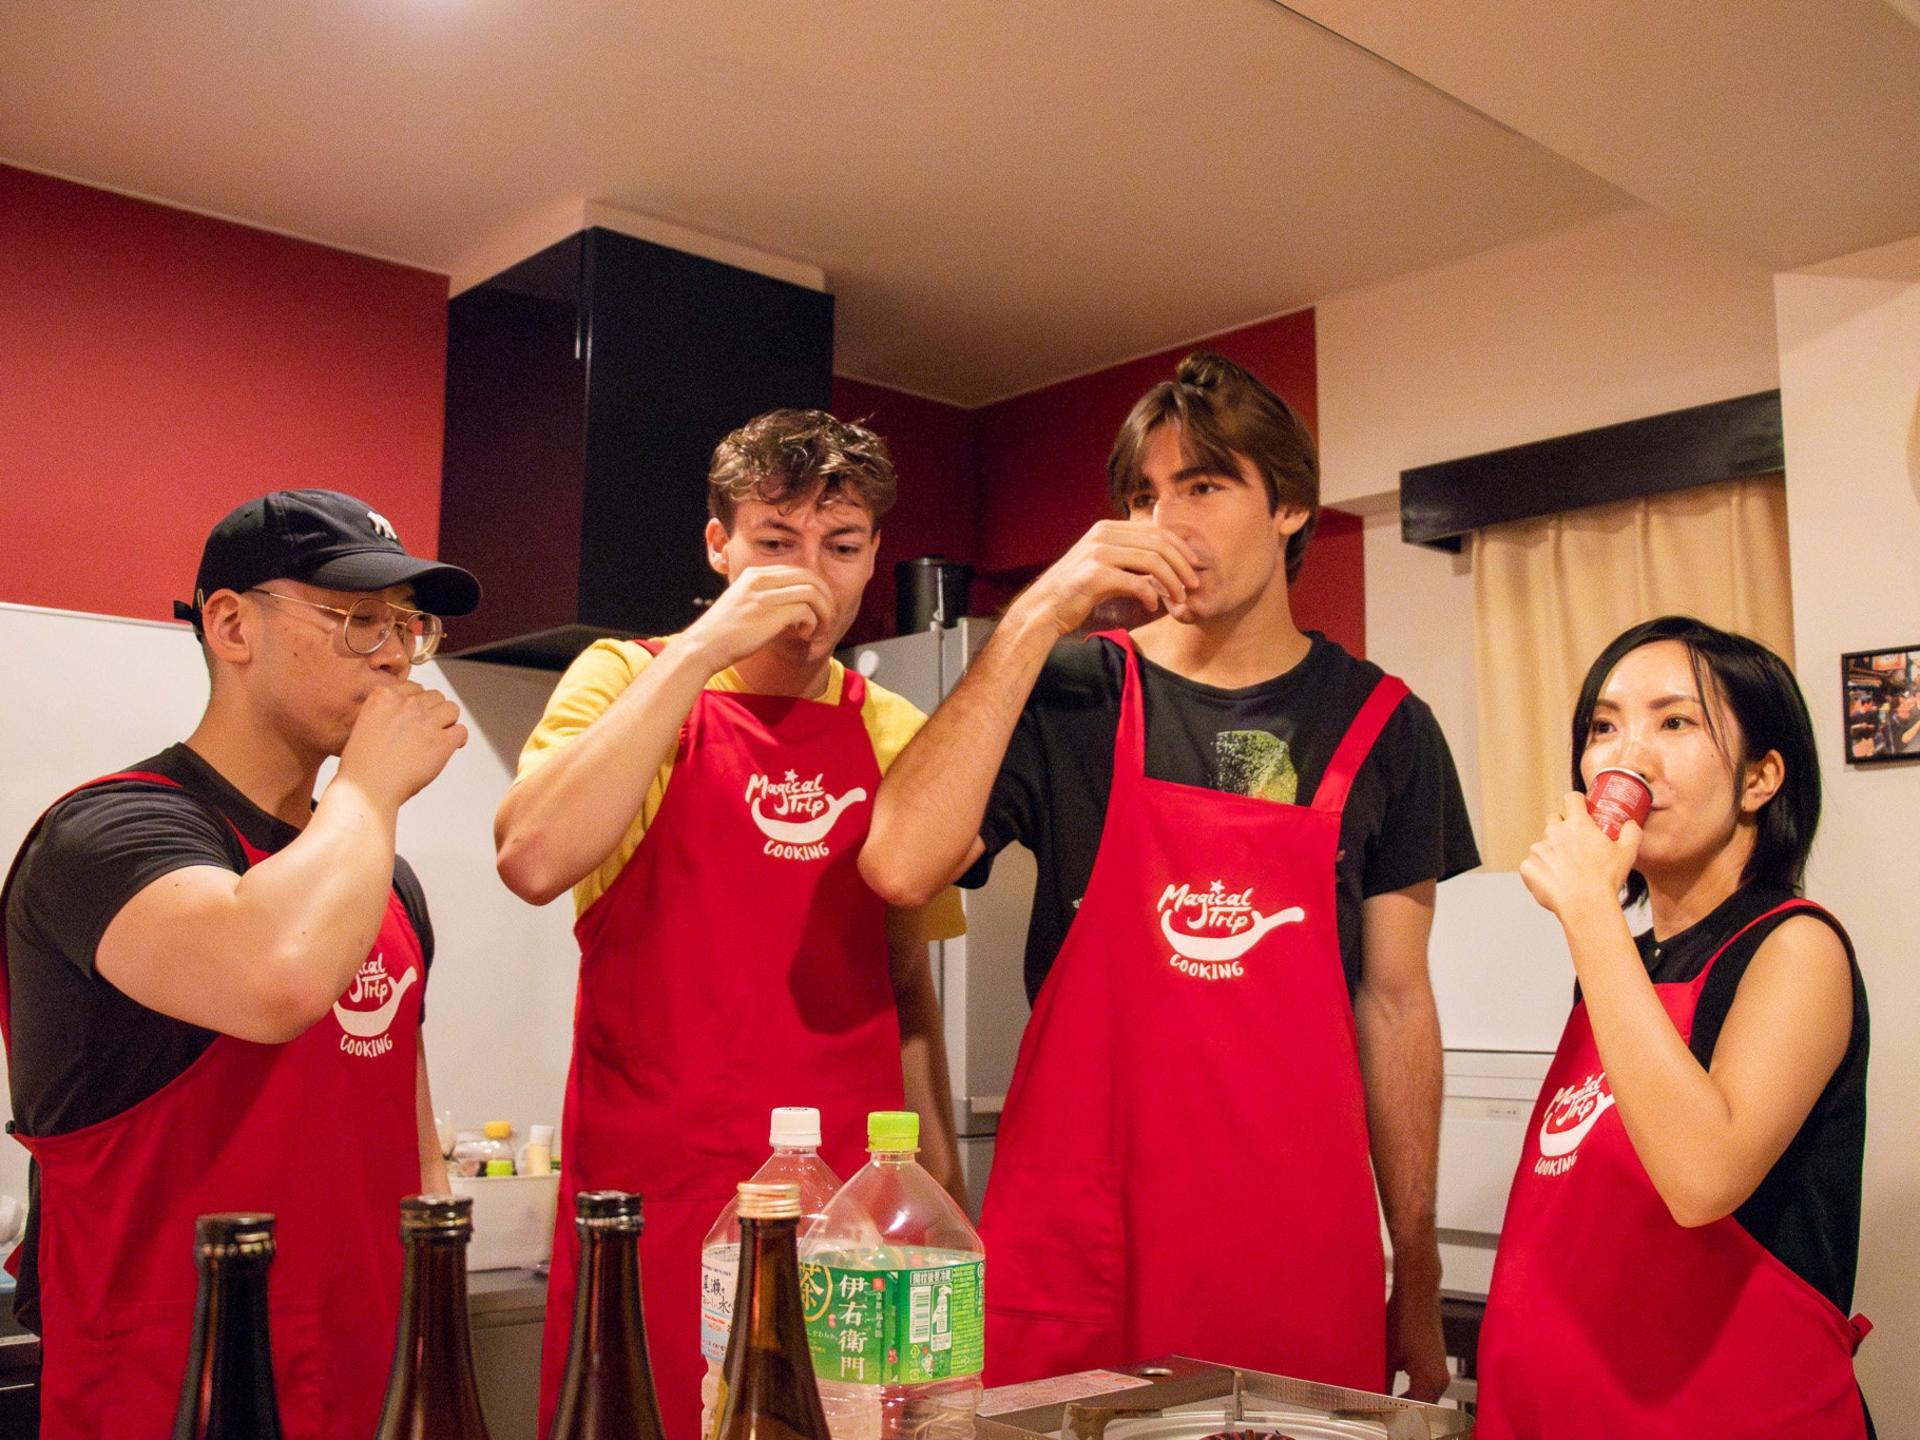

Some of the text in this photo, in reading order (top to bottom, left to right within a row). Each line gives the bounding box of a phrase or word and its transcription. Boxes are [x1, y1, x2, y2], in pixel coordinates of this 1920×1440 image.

[745, 769, 823, 816] Magical
[788, 791, 825, 818] Trip
[763, 840, 830, 861] COOKING
[1157, 880, 1253, 930] Magical
[1208, 906, 1252, 934] Trip
[1169, 953, 1244, 980] COOKING
[361, 972, 389, 1005] Trip
[340, 1033, 393, 1058] COOKING
[1534, 1150, 1579, 1176] COOKING
[838, 1273, 870, 1381] 伊右衛門
